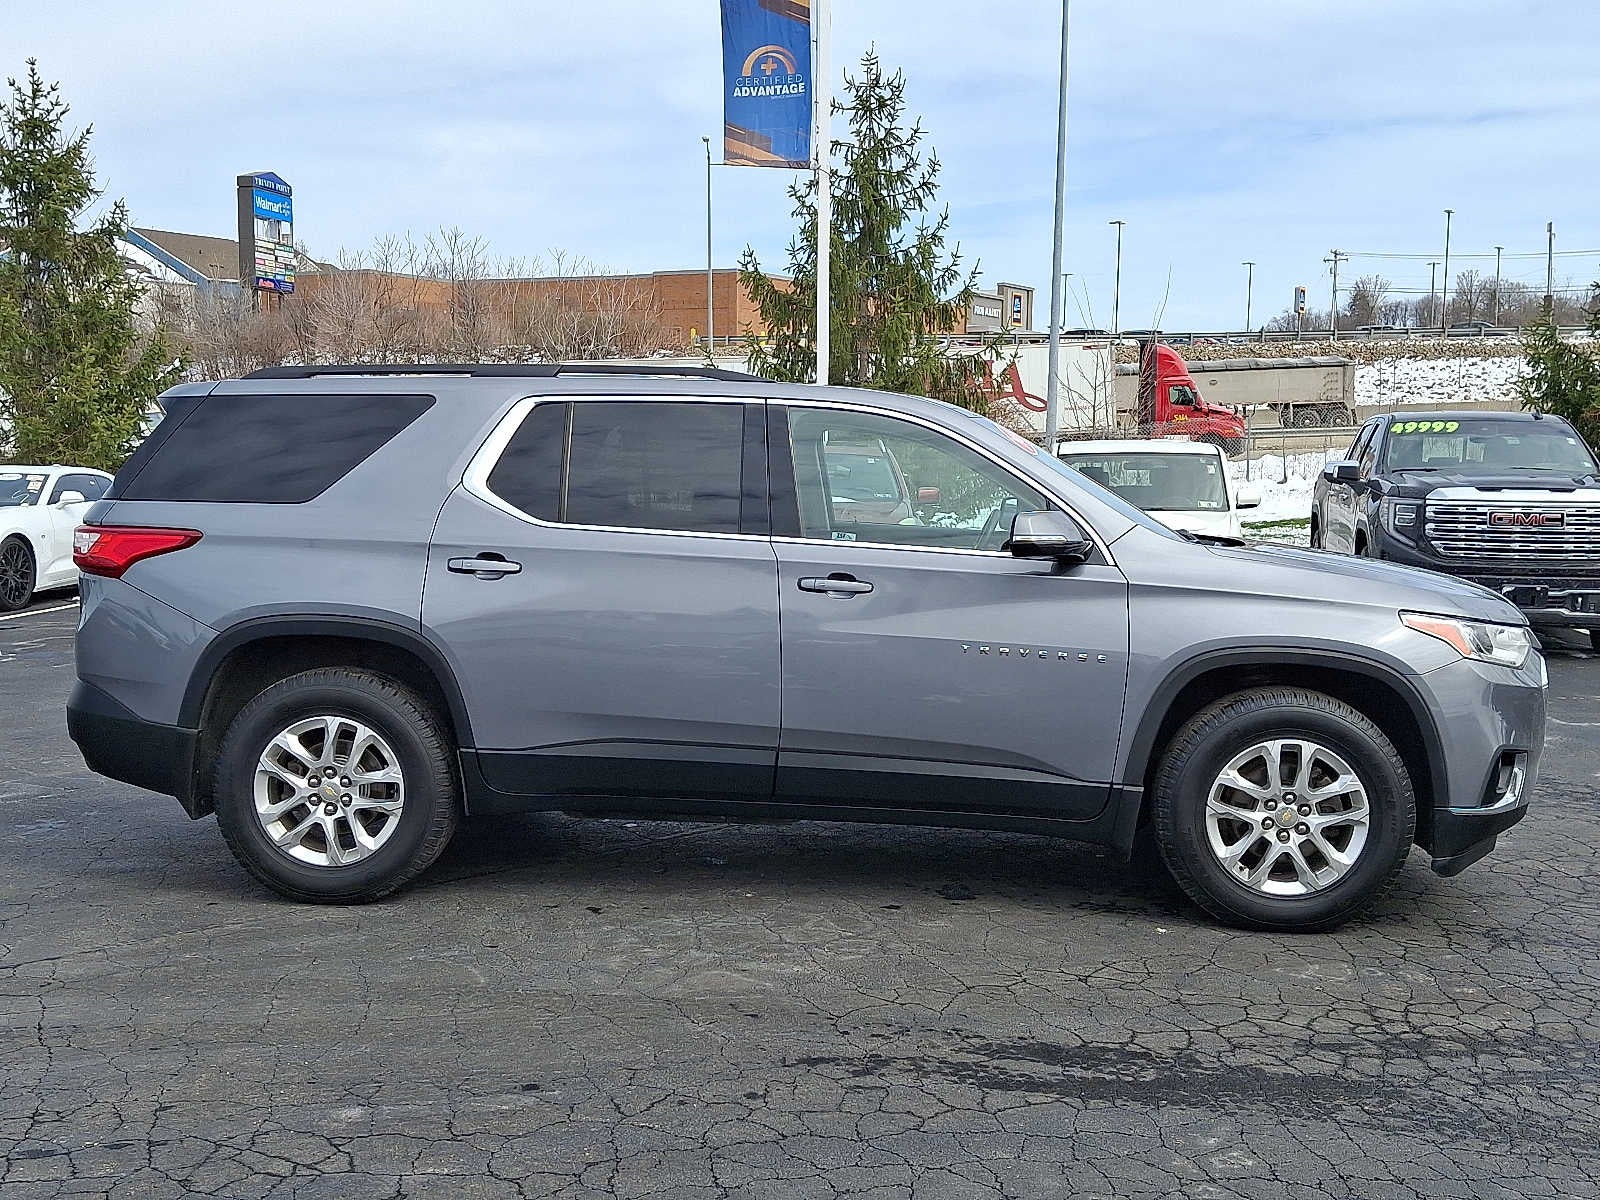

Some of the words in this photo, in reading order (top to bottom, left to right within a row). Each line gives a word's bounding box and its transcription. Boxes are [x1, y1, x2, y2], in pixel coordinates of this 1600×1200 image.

[735, 74, 803, 87] CERTIFIED
[733, 82, 806, 97] ADVANTAGE
[275, 183, 291, 194] POINT
[255, 195, 283, 214] Walmart
[1390, 421, 1460, 434] 49999
[1491, 513, 1562, 527] GMC
[960, 644, 1108, 663] TRAVERSE
